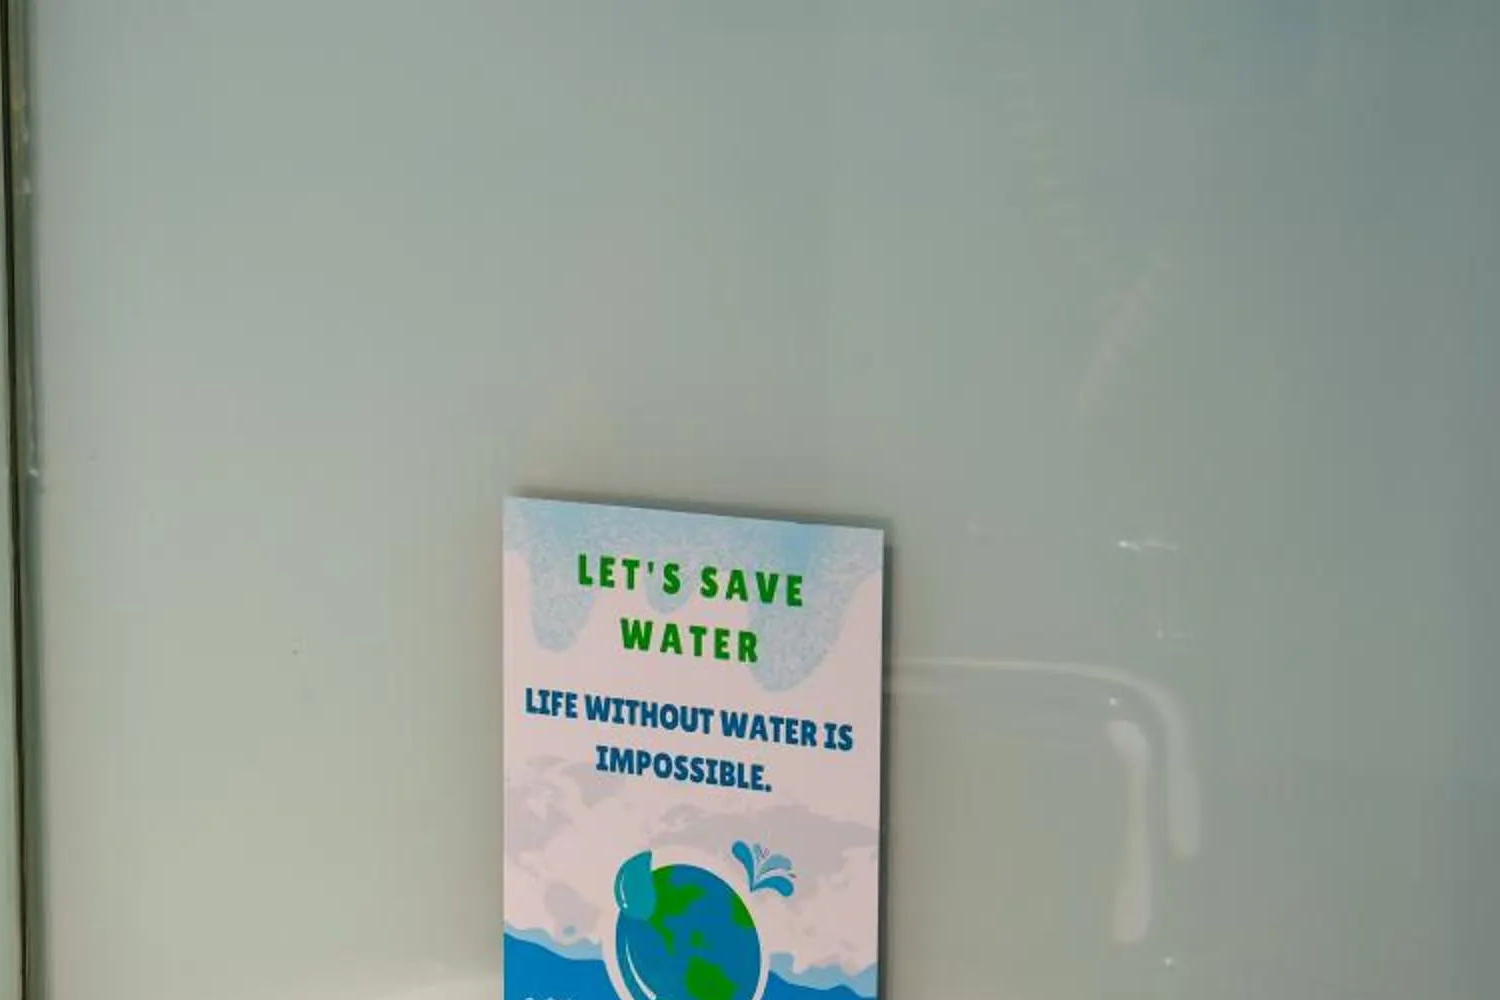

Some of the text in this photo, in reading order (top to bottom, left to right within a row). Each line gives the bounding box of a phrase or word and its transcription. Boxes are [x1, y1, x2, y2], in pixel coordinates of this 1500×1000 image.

[578, 554, 803, 607] LET'S SAVE
[620, 617, 758, 663] WATER
[525, 687, 853, 751] LIFE WITHOUT WATER IS
[596, 745, 772, 793] IMPOSSIBLE.
